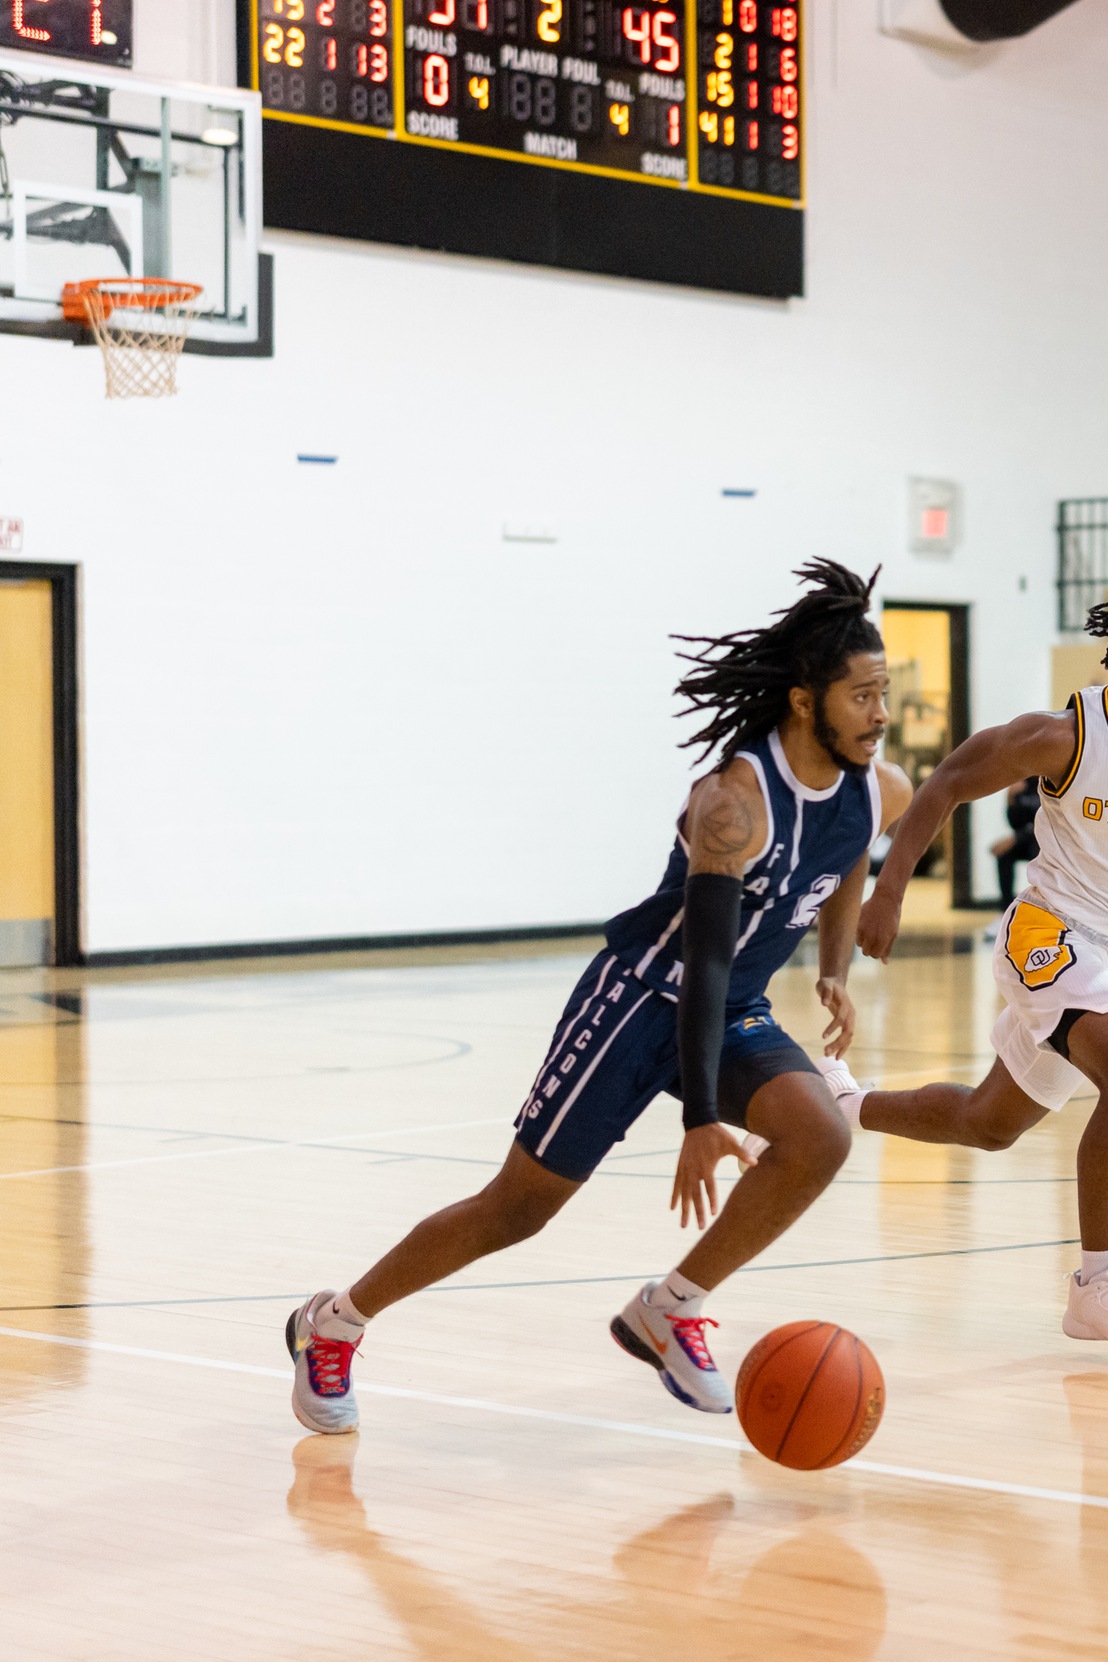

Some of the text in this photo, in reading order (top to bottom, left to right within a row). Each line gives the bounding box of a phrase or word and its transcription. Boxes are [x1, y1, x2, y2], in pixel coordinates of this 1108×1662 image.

[369, 0, 387, 36] 3
[537, 0, 562, 42] 2
[263, 23, 388, 82] 22 1 13
[406, 26, 457, 56] FOULS
[623, 8, 679, 72] 45
[715, 33, 797, 81] 2 1 6
[424, 55, 448, 106] 0
[501, 45, 600, 85] PLAYER FOUL
[469, 77, 489, 109] 4
[639, 72, 685, 102] FOULS
[707, 71, 734, 106] 15
[748, 81, 758, 109] 1
[408, 111, 458, 141] SCORE
[609, 103, 629, 135] 4
[669, 105, 679, 146] 1
[700, 111, 798, 160] 41 1 3
[524, 132, 577, 161] MATCH
[642, 152, 686, 181] SCORE
[785, 873, 842, 929] 2
